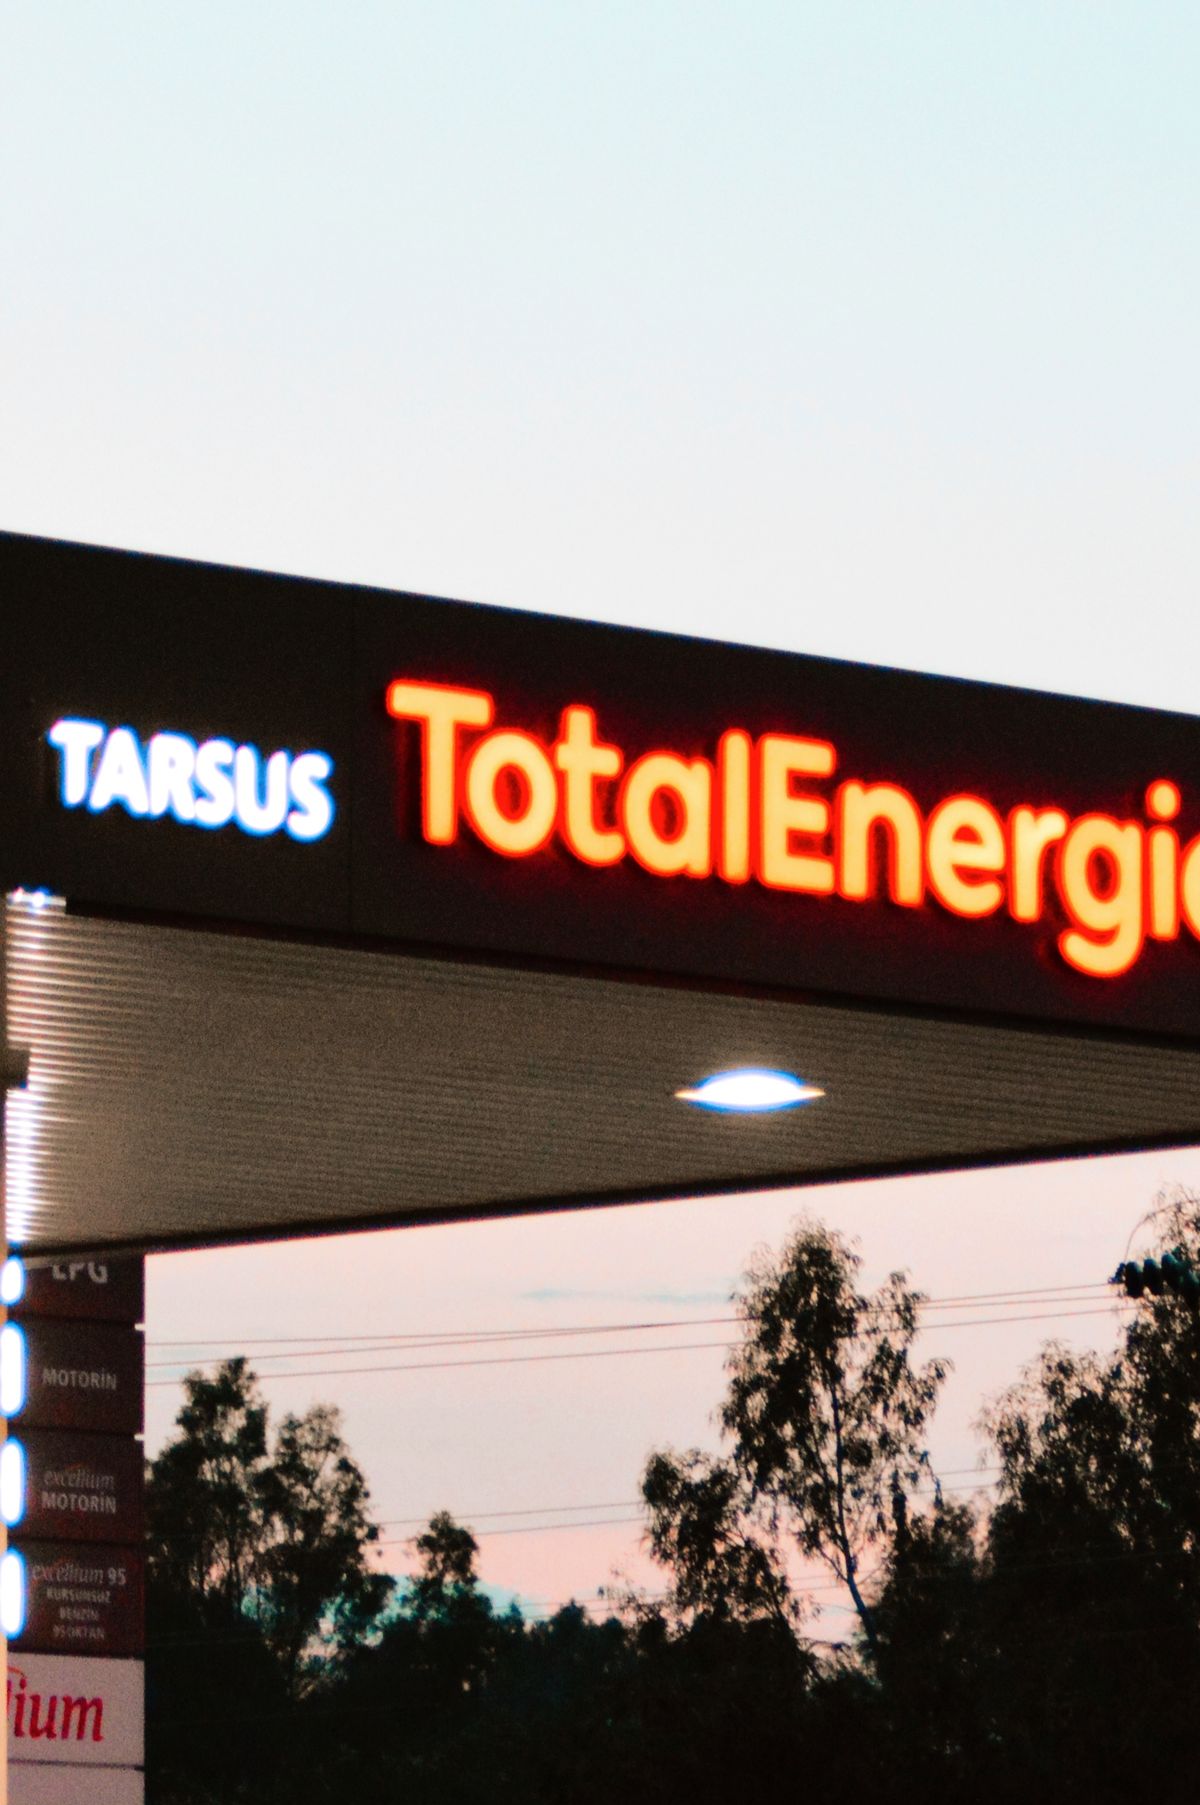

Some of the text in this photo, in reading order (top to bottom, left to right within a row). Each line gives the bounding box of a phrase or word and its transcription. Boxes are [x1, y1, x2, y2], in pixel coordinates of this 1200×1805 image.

[50, 716, 335, 841] TARSUS
[43, 1469, 115, 1490] excellium
[107, 1567, 126, 1586] 95
